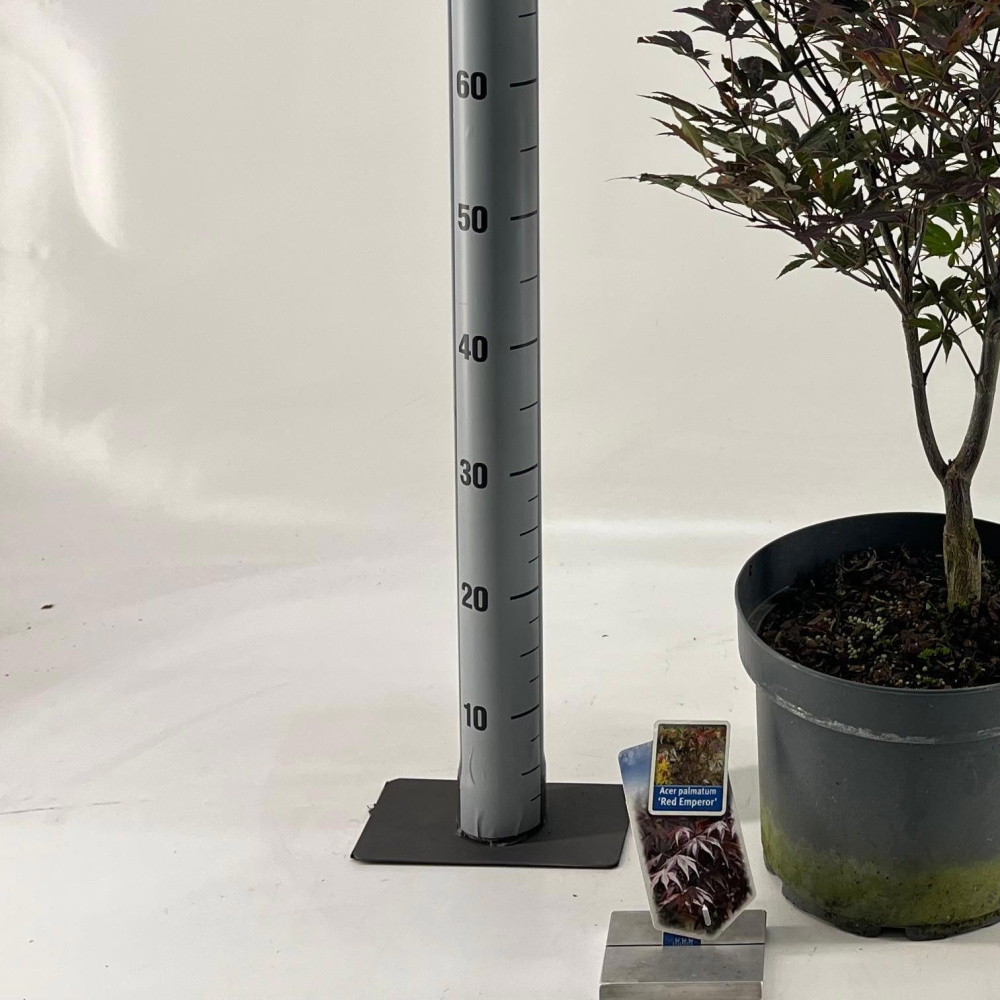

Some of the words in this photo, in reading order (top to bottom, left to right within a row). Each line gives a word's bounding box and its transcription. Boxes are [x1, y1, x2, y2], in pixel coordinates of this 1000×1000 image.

[456, 70, 487, 101] 60
[458, 203, 487, 234] 50
[459, 333, 489, 363] 40
[460, 458, 488, 489] 30
[461, 582, 488, 612] 20
[463, 702, 487, 731] 10
[659, 787, 677, 795] Acer
[678, 787, 717, 797] palmatum
